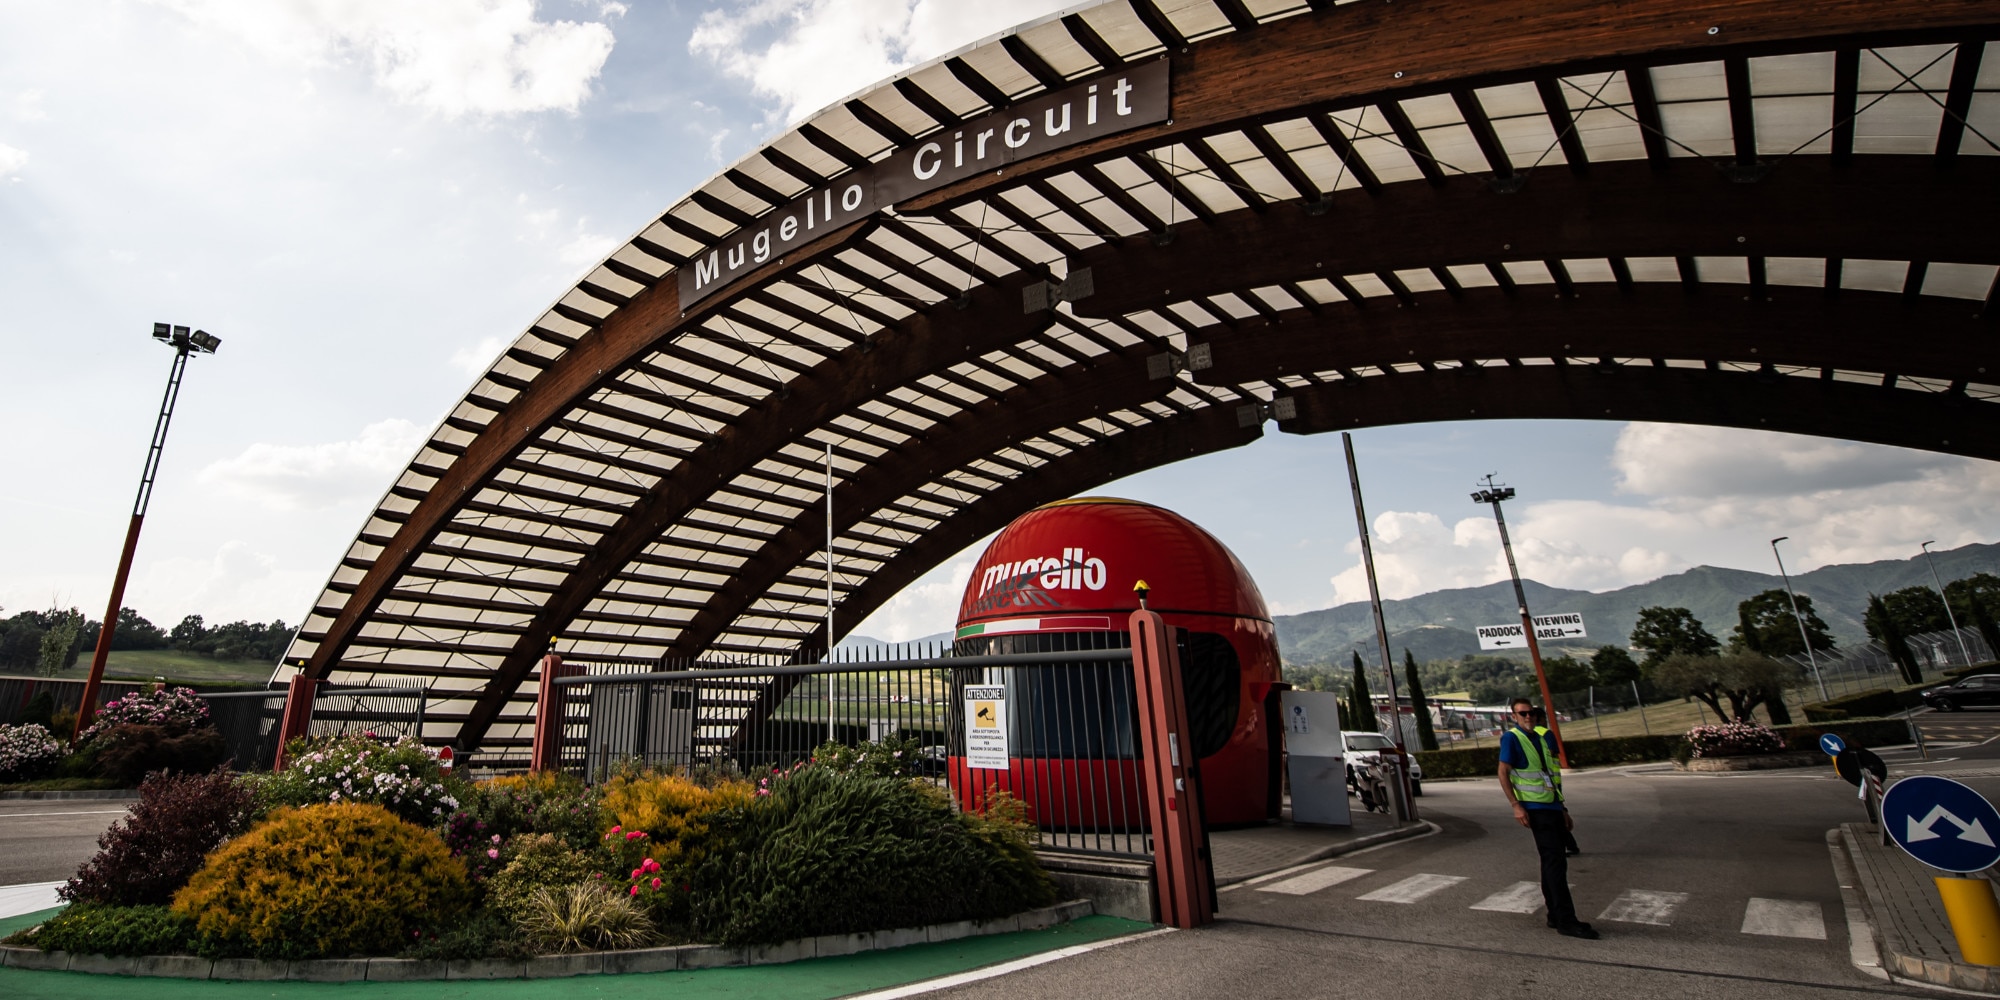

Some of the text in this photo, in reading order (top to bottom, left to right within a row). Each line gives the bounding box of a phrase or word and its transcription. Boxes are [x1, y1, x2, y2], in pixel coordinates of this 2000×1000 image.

[694, 77, 1133, 291] Mugello Circuit
[978, 547, 1107, 598] mugello
[1533, 614, 1580, 626] VIEWING
[1479, 626, 1523, 638] PADDOCK
[1537, 629, 1565, 638] AREA
